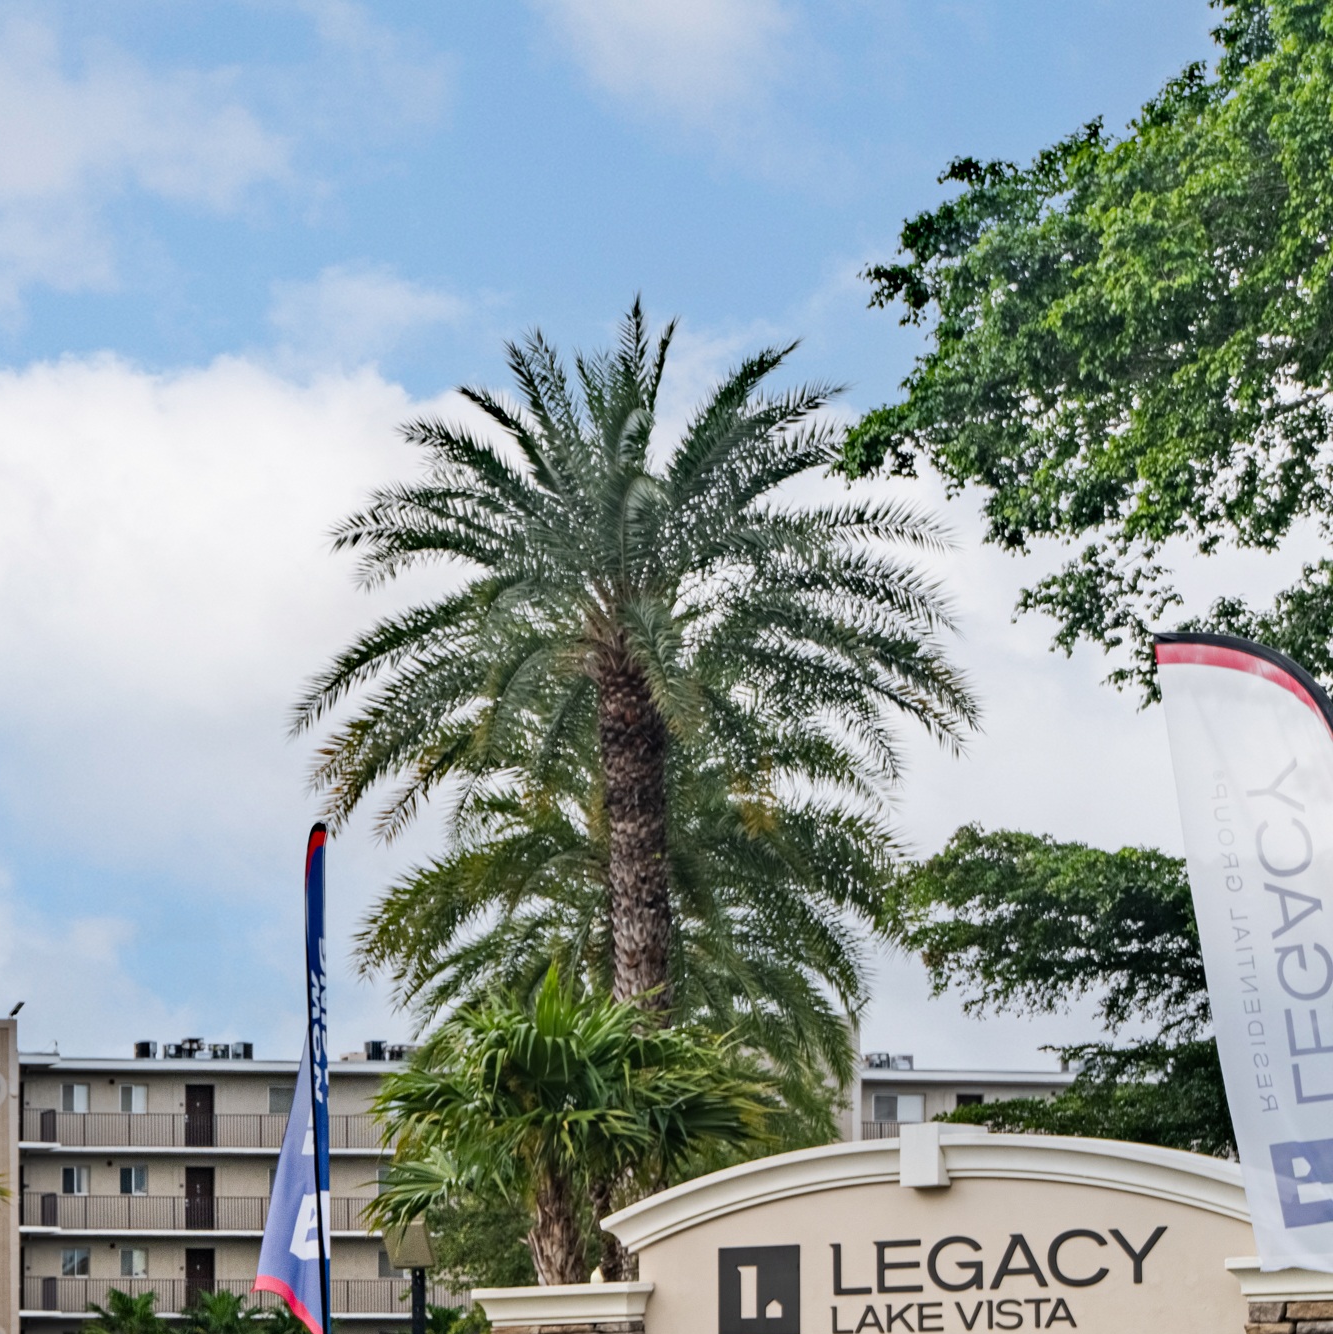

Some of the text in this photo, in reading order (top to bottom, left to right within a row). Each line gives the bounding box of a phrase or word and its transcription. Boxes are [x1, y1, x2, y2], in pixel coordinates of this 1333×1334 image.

[311, 969, 323, 1104] NOW
[829, 1225, 1169, 1296] LEGACY
[829, 1298, 1078, 1334] LAKE VISTA
